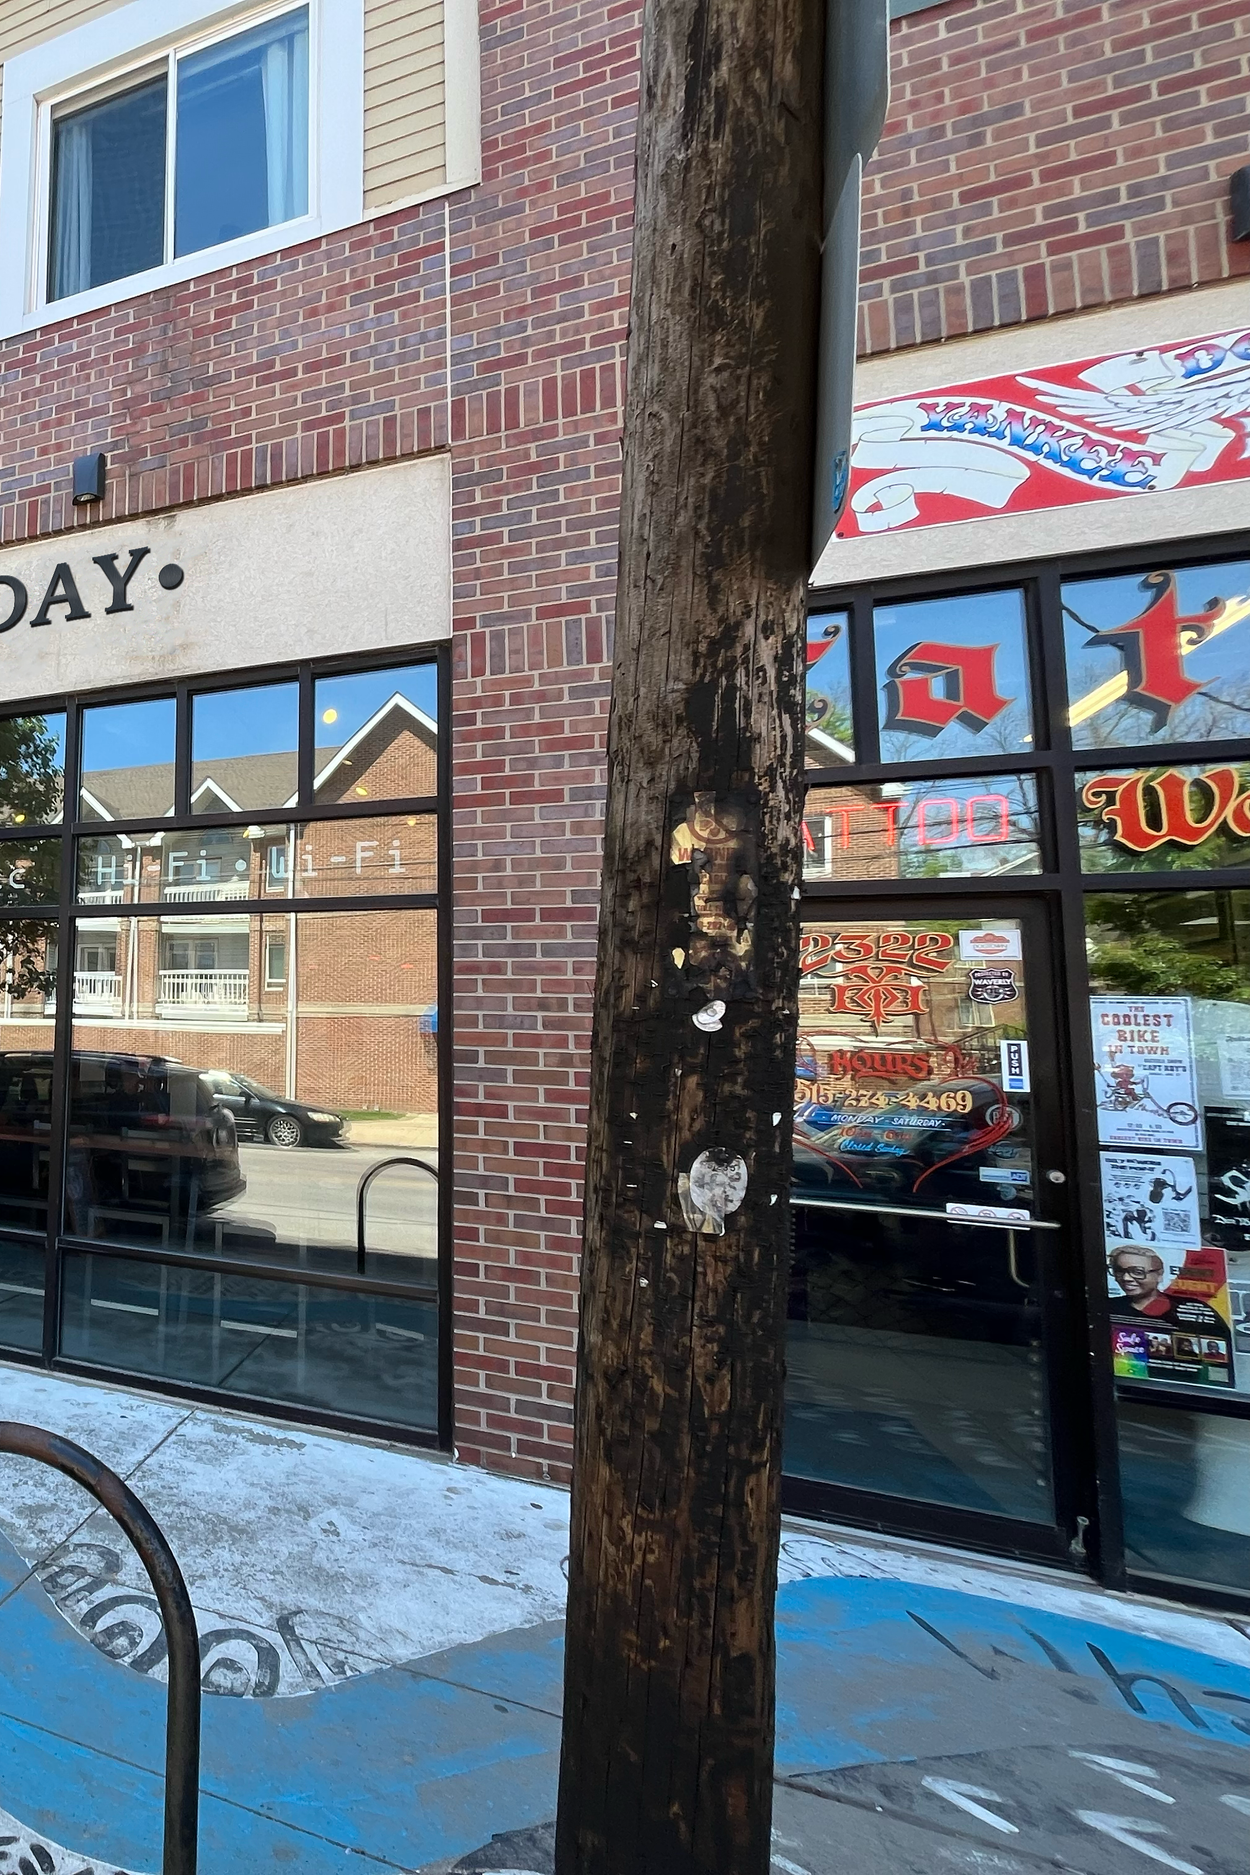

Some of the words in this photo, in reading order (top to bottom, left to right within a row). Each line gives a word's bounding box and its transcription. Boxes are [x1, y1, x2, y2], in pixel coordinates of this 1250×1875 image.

[917, 401, 1167, 491] YANKEE
[799, 932, 955, 977] 2322
[1101, 1014, 1174, 1027] COOLEST
[1116, 1029, 1160, 1043] BIKE
[1127, 1046, 1170, 1055] TOWN
[1010, 1045, 1020, 1075] PUSH
[831, 1114, 884, 1124] MONDAY
[891, 1118, 942, 1127] SATURDAY
